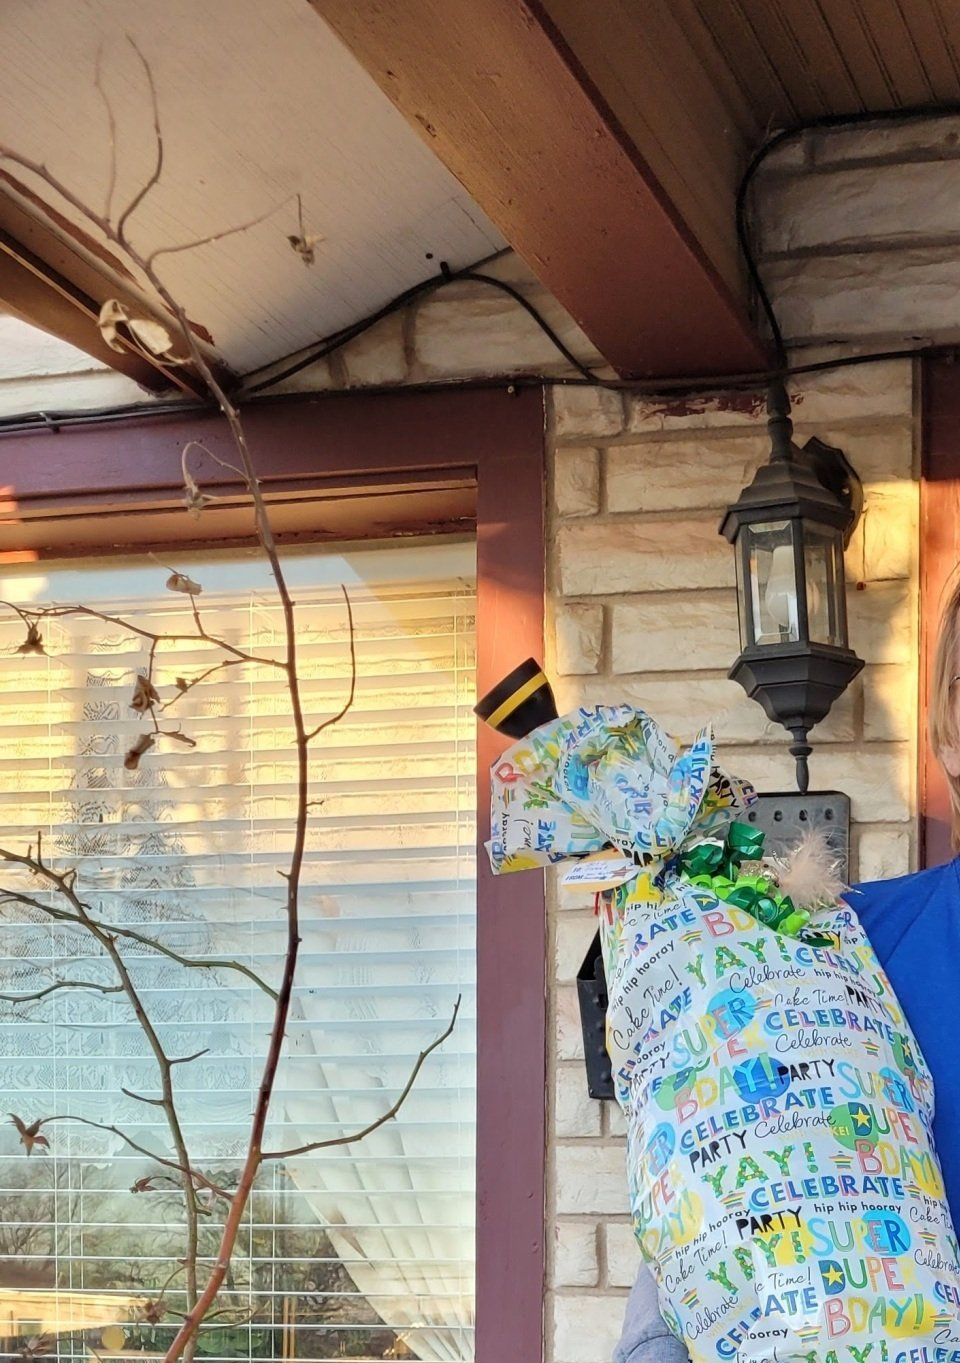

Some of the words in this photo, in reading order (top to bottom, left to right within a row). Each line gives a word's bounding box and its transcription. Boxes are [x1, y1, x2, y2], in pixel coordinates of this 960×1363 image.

[623, 977, 639, 994] hip
[636, 940, 675, 976] hooray
[730, 965, 805, 993] Celebrate
[814, 968, 832, 979] hip
[835, 971, 849, 983] hip
[613, 1006, 650, 1050] Cake
[764, 1008, 895, 1043] CELEBRATE
[775, 1029, 852, 1052] Celebrate
[777, 1059, 835, 1084] PARTY
[680, 1087, 834, 1154] CELEBRATE
[754, 1111, 836, 1138] Celebrate
[689, 1130, 747, 1173] PARTY
[701, 1142, 818, 1198] YAY!
[749, 1175, 905, 1212] CELEBRATE
[814, 1203, 834, 1215] hip
[839, 1202, 857, 1214] hip
[861, 1201, 902, 1214] hooray
[675, 1245, 690, 1259] hip
[693, 1232, 707, 1246] hip
[709, 1209, 751, 1232] hooray
[735, 1206, 801, 1241] PARTY
[807, 1217, 909, 1257] SUPER
[665, 1259, 695, 1294] Cake
[694, 1230, 728, 1267] Time!
[768, 1266, 812, 1291] Time!
[686, 1295, 739, 1340] Celebrate
[824, 1293, 924, 1339] BDAY!
